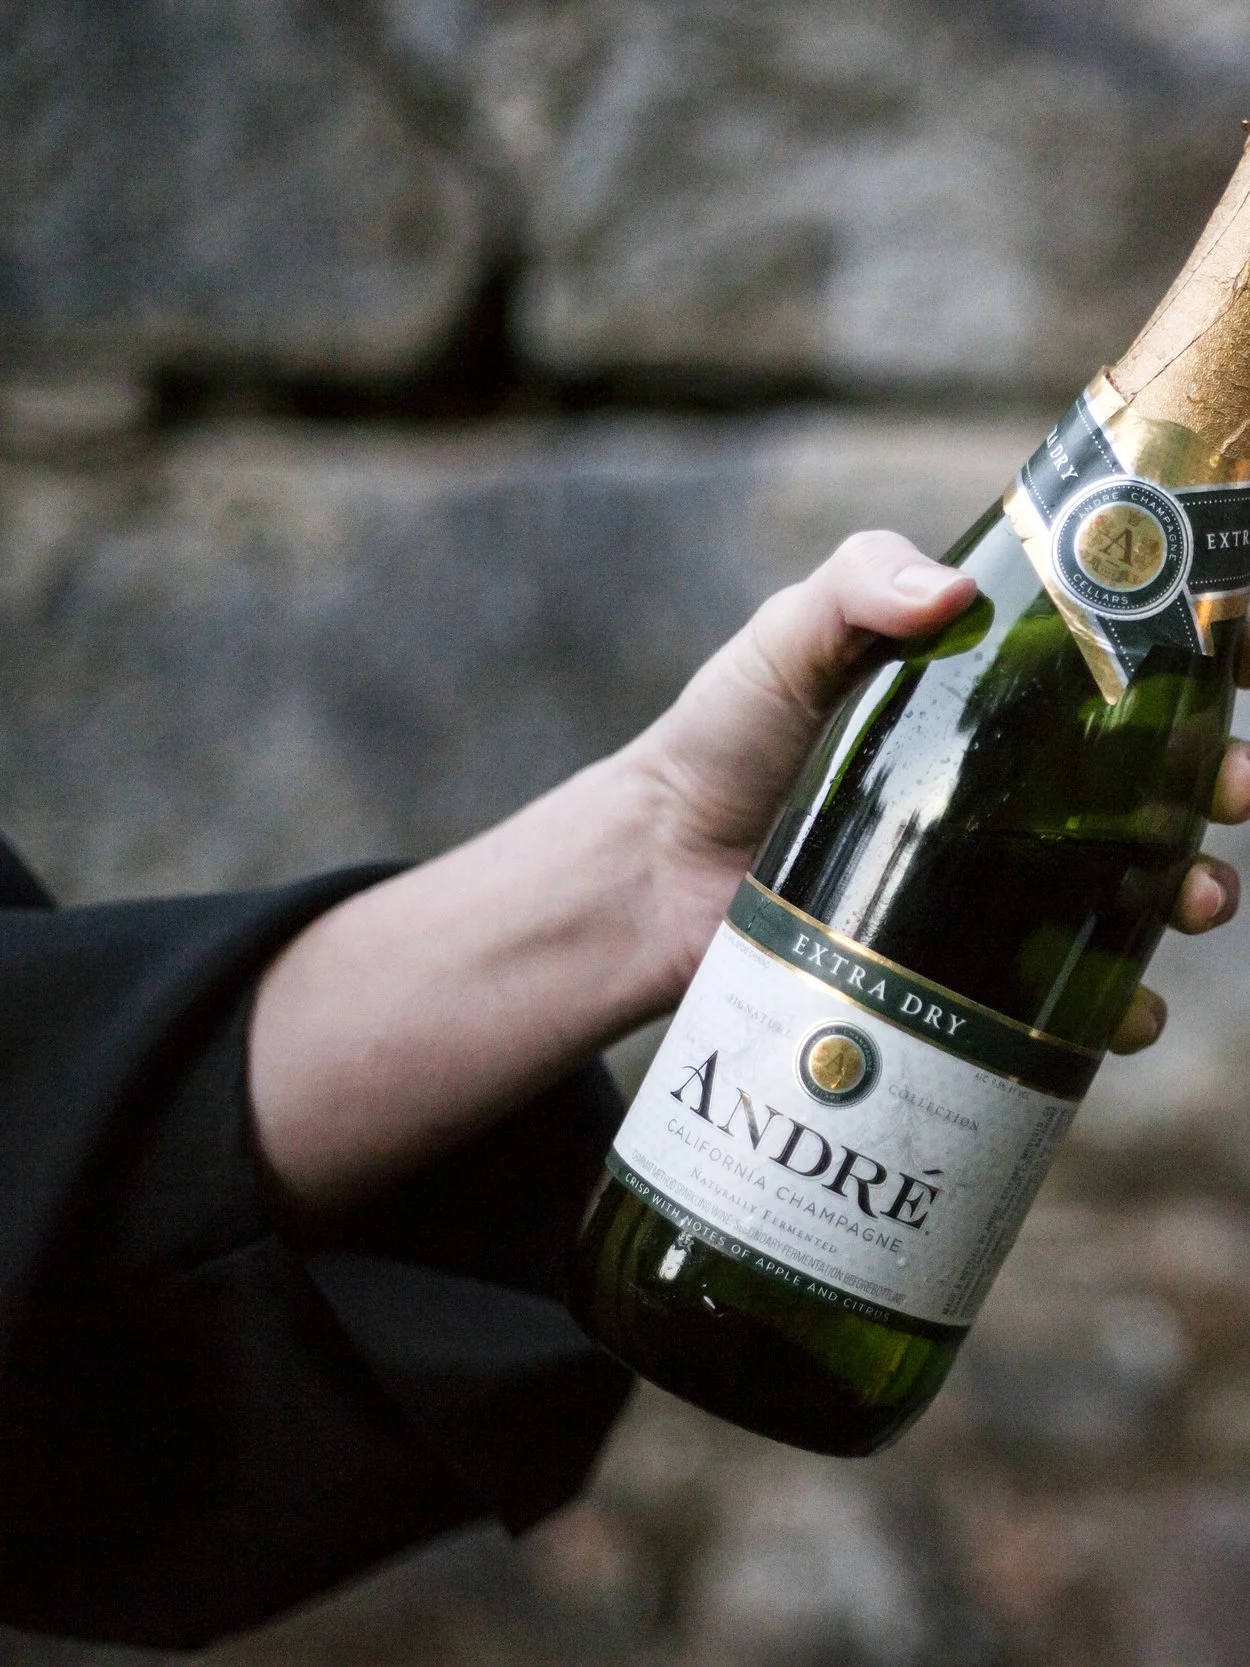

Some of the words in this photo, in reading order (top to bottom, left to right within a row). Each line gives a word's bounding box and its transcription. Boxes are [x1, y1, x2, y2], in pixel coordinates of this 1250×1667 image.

[1048, 442, 1079, 480] DRY
[1131, 493, 1177, 561] CHAMPAGNE
[1073, 574, 1129, 605] CELLARS
[792, 933, 887, 1001] EXTRA
[901, 992, 967, 1036] DRY
[670, 1049, 943, 1231] ANDRÉ
[888, 1084, 980, 1133] COLLECTION
[667, 1118, 767, 1190] CALIFORNIA
[776, 1186, 903, 1253] CHAMPAGNE
[625, 1172, 650, 1195] CRISP
[652, 1193, 680, 1218] WITH
[682, 1215, 725, 1246] NOTES
[731, 1244, 751, 1259] OF
[755, 1257, 802, 1286] APPLE
[806, 1282, 838, 1302] AND
[843, 1297, 891, 1322] CITRUS
